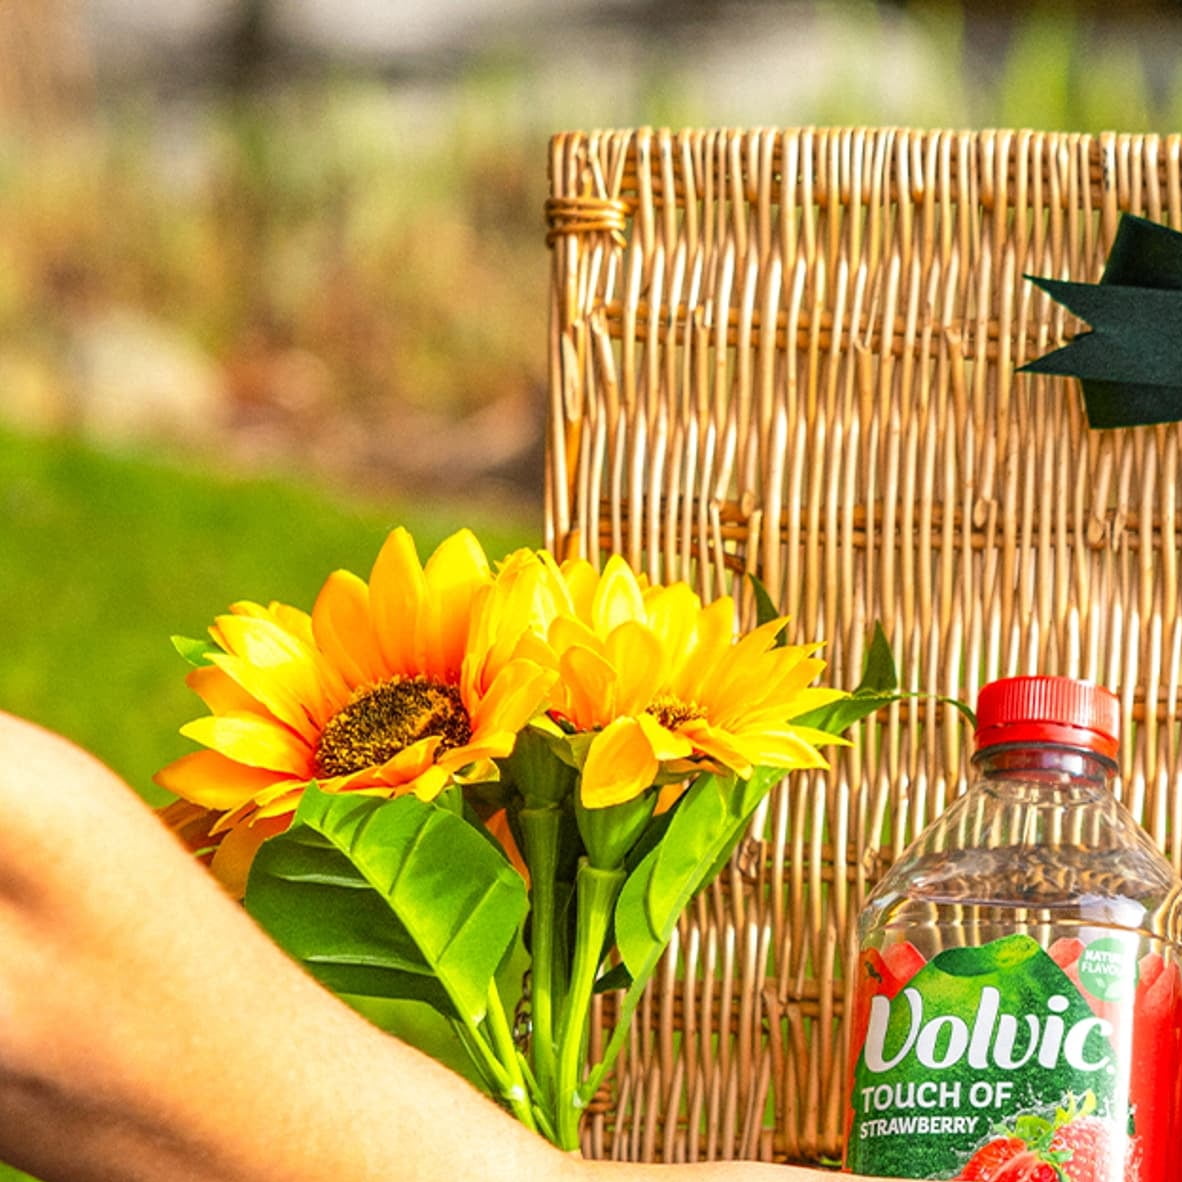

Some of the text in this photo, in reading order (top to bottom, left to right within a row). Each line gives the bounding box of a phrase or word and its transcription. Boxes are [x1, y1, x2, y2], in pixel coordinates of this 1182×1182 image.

[864, 986, 1114, 1073] Volvic
[862, 1081, 1014, 1114] TOUCH OF
[860, 1116, 979, 1139] STRAWBERRY
